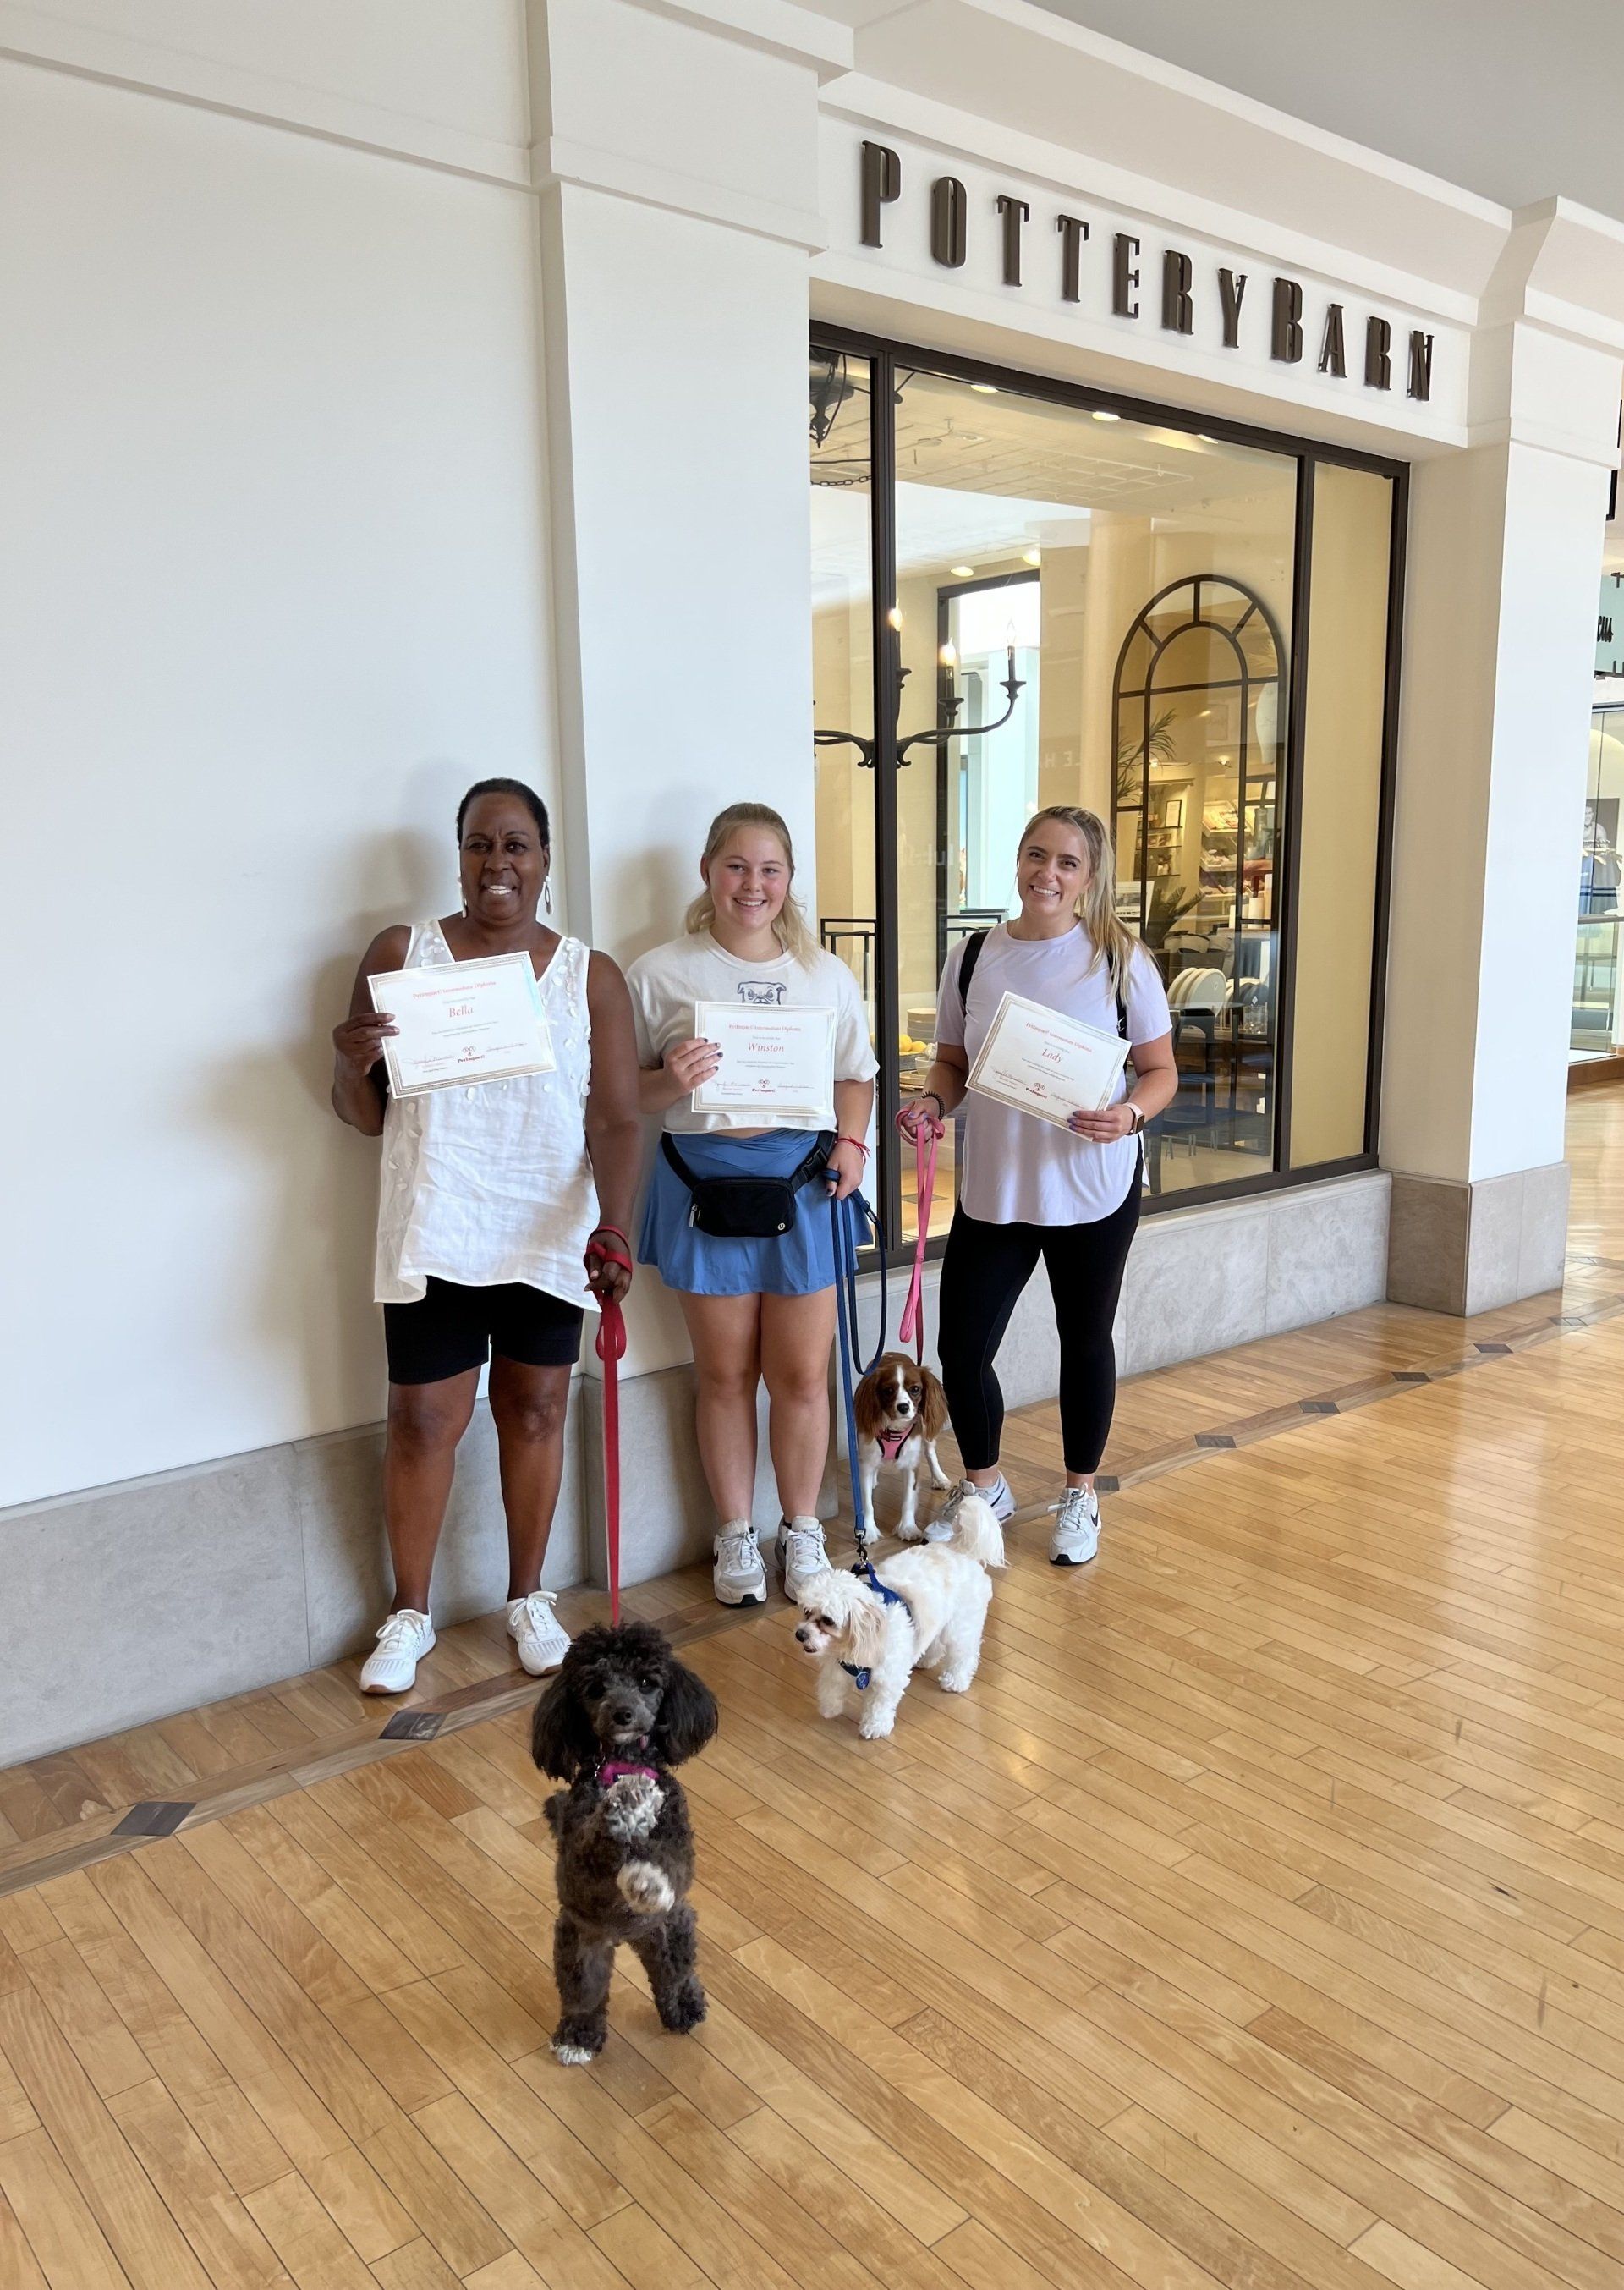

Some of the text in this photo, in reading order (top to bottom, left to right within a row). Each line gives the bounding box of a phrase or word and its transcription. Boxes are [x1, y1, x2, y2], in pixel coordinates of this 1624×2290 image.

[449, 1005, 473, 1018] Bella
[748, 1042, 785, 1053] Winston
[1041, 1048, 1062, 1064] Lady
